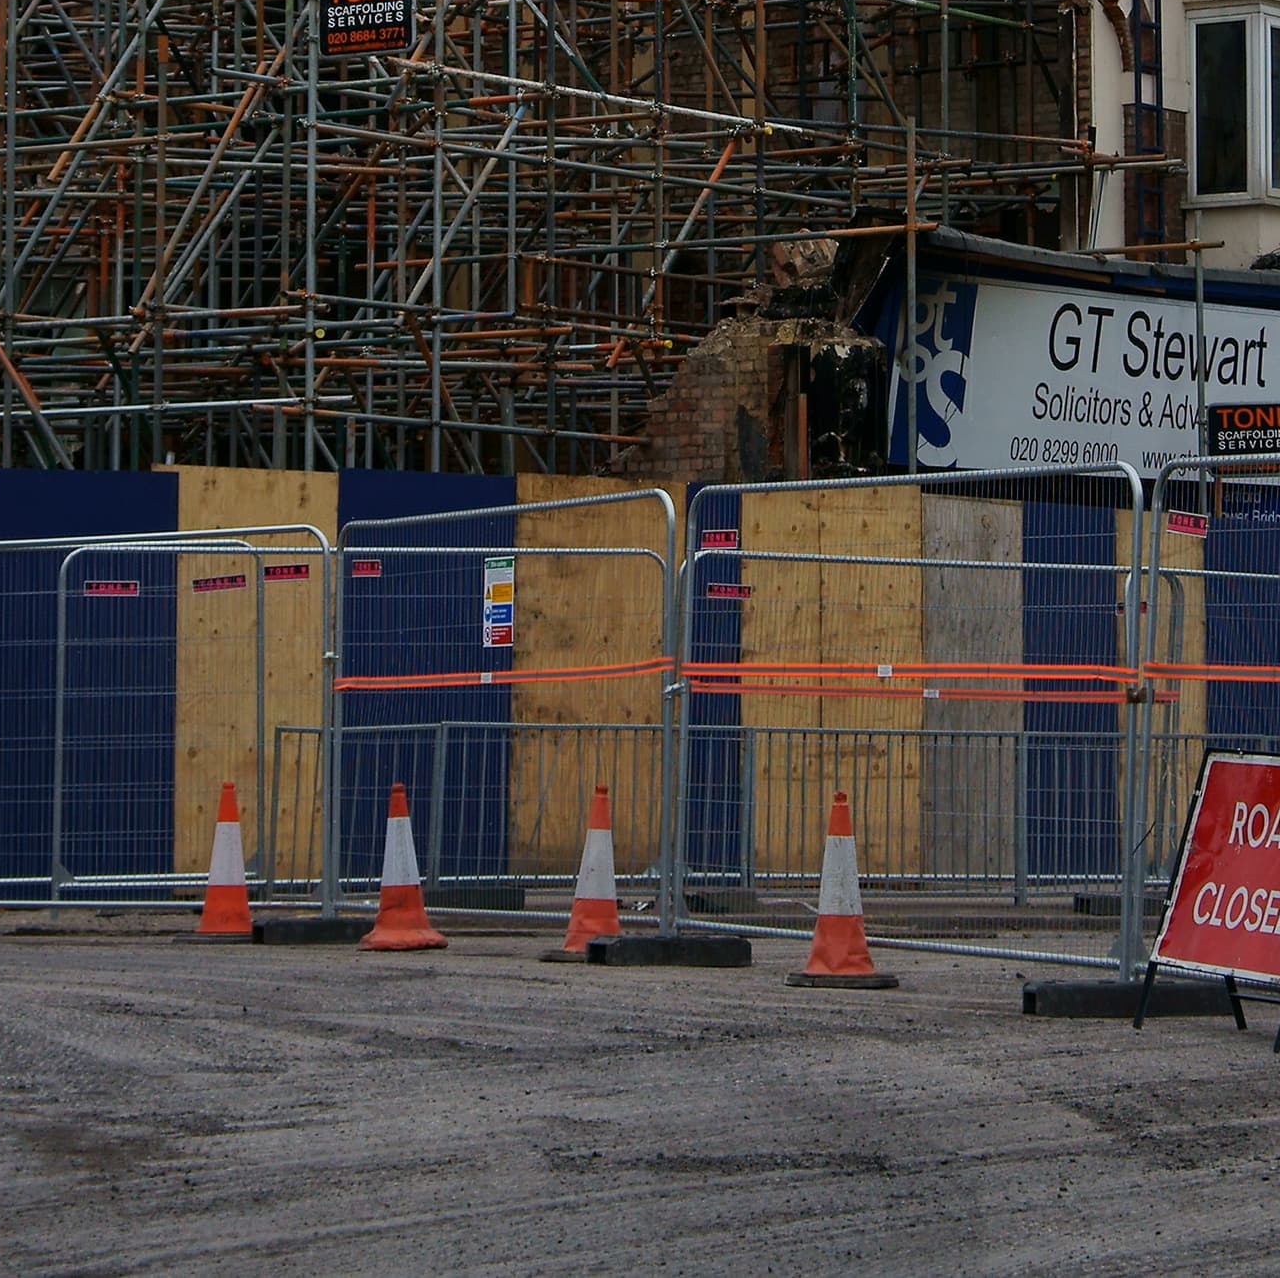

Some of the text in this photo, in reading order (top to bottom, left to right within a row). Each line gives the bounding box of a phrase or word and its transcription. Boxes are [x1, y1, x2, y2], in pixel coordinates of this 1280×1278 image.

[327, 1, 404, 17] SCAFFOLDING
[328, 11, 404, 28] SERVICES
[328, 27, 405, 45] 020 8684 3771
[1048, 302, 1267, 388] GT Stewart
[1032, 382, 1200, 430] Solicitors & Adv
[1010, 436, 1119, 464] 020 8299 6000
